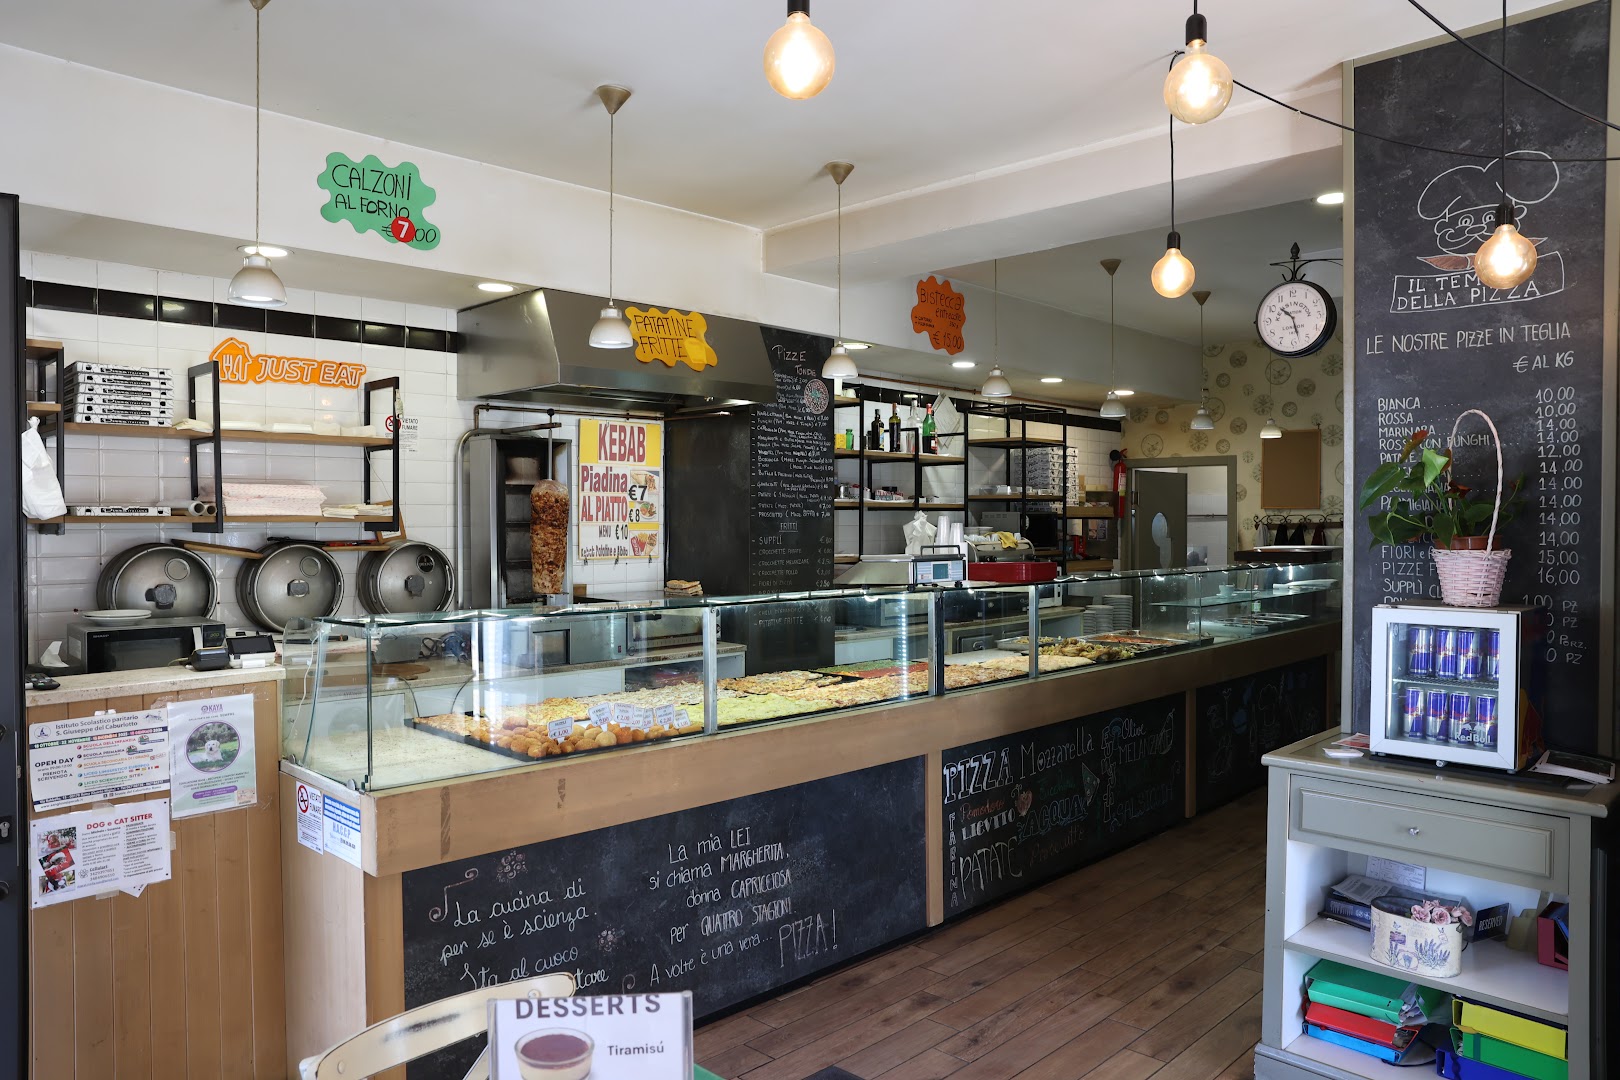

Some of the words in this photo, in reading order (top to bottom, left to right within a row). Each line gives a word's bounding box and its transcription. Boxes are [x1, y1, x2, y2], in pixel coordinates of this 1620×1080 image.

[335, 193, 357, 210] AL
[360, 196, 410, 218] FORNO
[1408, 278, 1425, 293] IL
[1397, 290, 1456, 310] DELLA
[634, 315, 696, 338] PATATINE
[1366, 335, 1383, 355] LE
[1392, 332, 1448, 353] NOSTRE
[1456, 328, 1493, 349] PIZZE
[1500, 326, 1514, 343] IN
[1520, 321, 1571, 342] TEGLIA
[640, 336, 687, 358] FRITTE
[256, 356, 318, 383] JUST
[319, 362, 366, 387] EAT
[1532, 352, 1550, 370] AL
[1555, 351, 1574, 367] KG
[1378, 397, 1421, 412] BIANCA
[1378, 412, 1414, 427] ROSSA
[598, 424, 646, 462] KEBAB
[581, 465, 628, 493] Piadina
[581, 496, 594, 521] AL
[596, 496, 628, 522] PIATTO
[635, 509, 640, 522] 8
[599, 525, 611, 538] MENU
[621, 524, 628, 540] 10
[1382, 545, 1416, 559] FIORI
[1382, 562, 1424, 577] PIZZE
[63, 727, 93, 736] Giuseppe
[105, 721, 138, 730] Caburlotto
[80, 718, 111, 727] Scolastico
[112, 715, 139, 724] paritario
[35, 759, 57, 768] OPEN
[43, 769, 68, 777] PRENOTA
[943, 747, 1014, 805] PIZZA
[86, 821, 106, 830] DOG
[114, 817, 128, 826] CAT
[130, 813, 153, 823] SITTER
[1022, 794, 1083, 838] ACQUA
[668, 843, 688, 864] La
[697, 833, 722, 855] mia
[730, 827, 750, 849] LEI
[649, 870, 660, 890] si
[666, 862, 713, 888] chiama
[959, 836, 1023, 900] PATATE
[686, 887, 721, 908] donna
[731, 869, 792, 899] CAPRICCIOSA
[454, 901, 481, 928] La
[489, 890, 553, 919] cucina
[563, 877, 586, 901] di
[670, 923, 689, 945] per
[701, 909, 743, 937] QUATTRO
[1479, 915, 1503, 931] RESERVED
[440, 940, 469, 967] per
[476, 930, 497, 949] se
[509, 957, 530, 981] al
[534, 946, 579, 973] cuoco
[650, 963, 660, 987] A
[665, 957, 696, 979] volte
[712, 941, 734, 960] una
[515, 994, 662, 1020] DESSERTS
